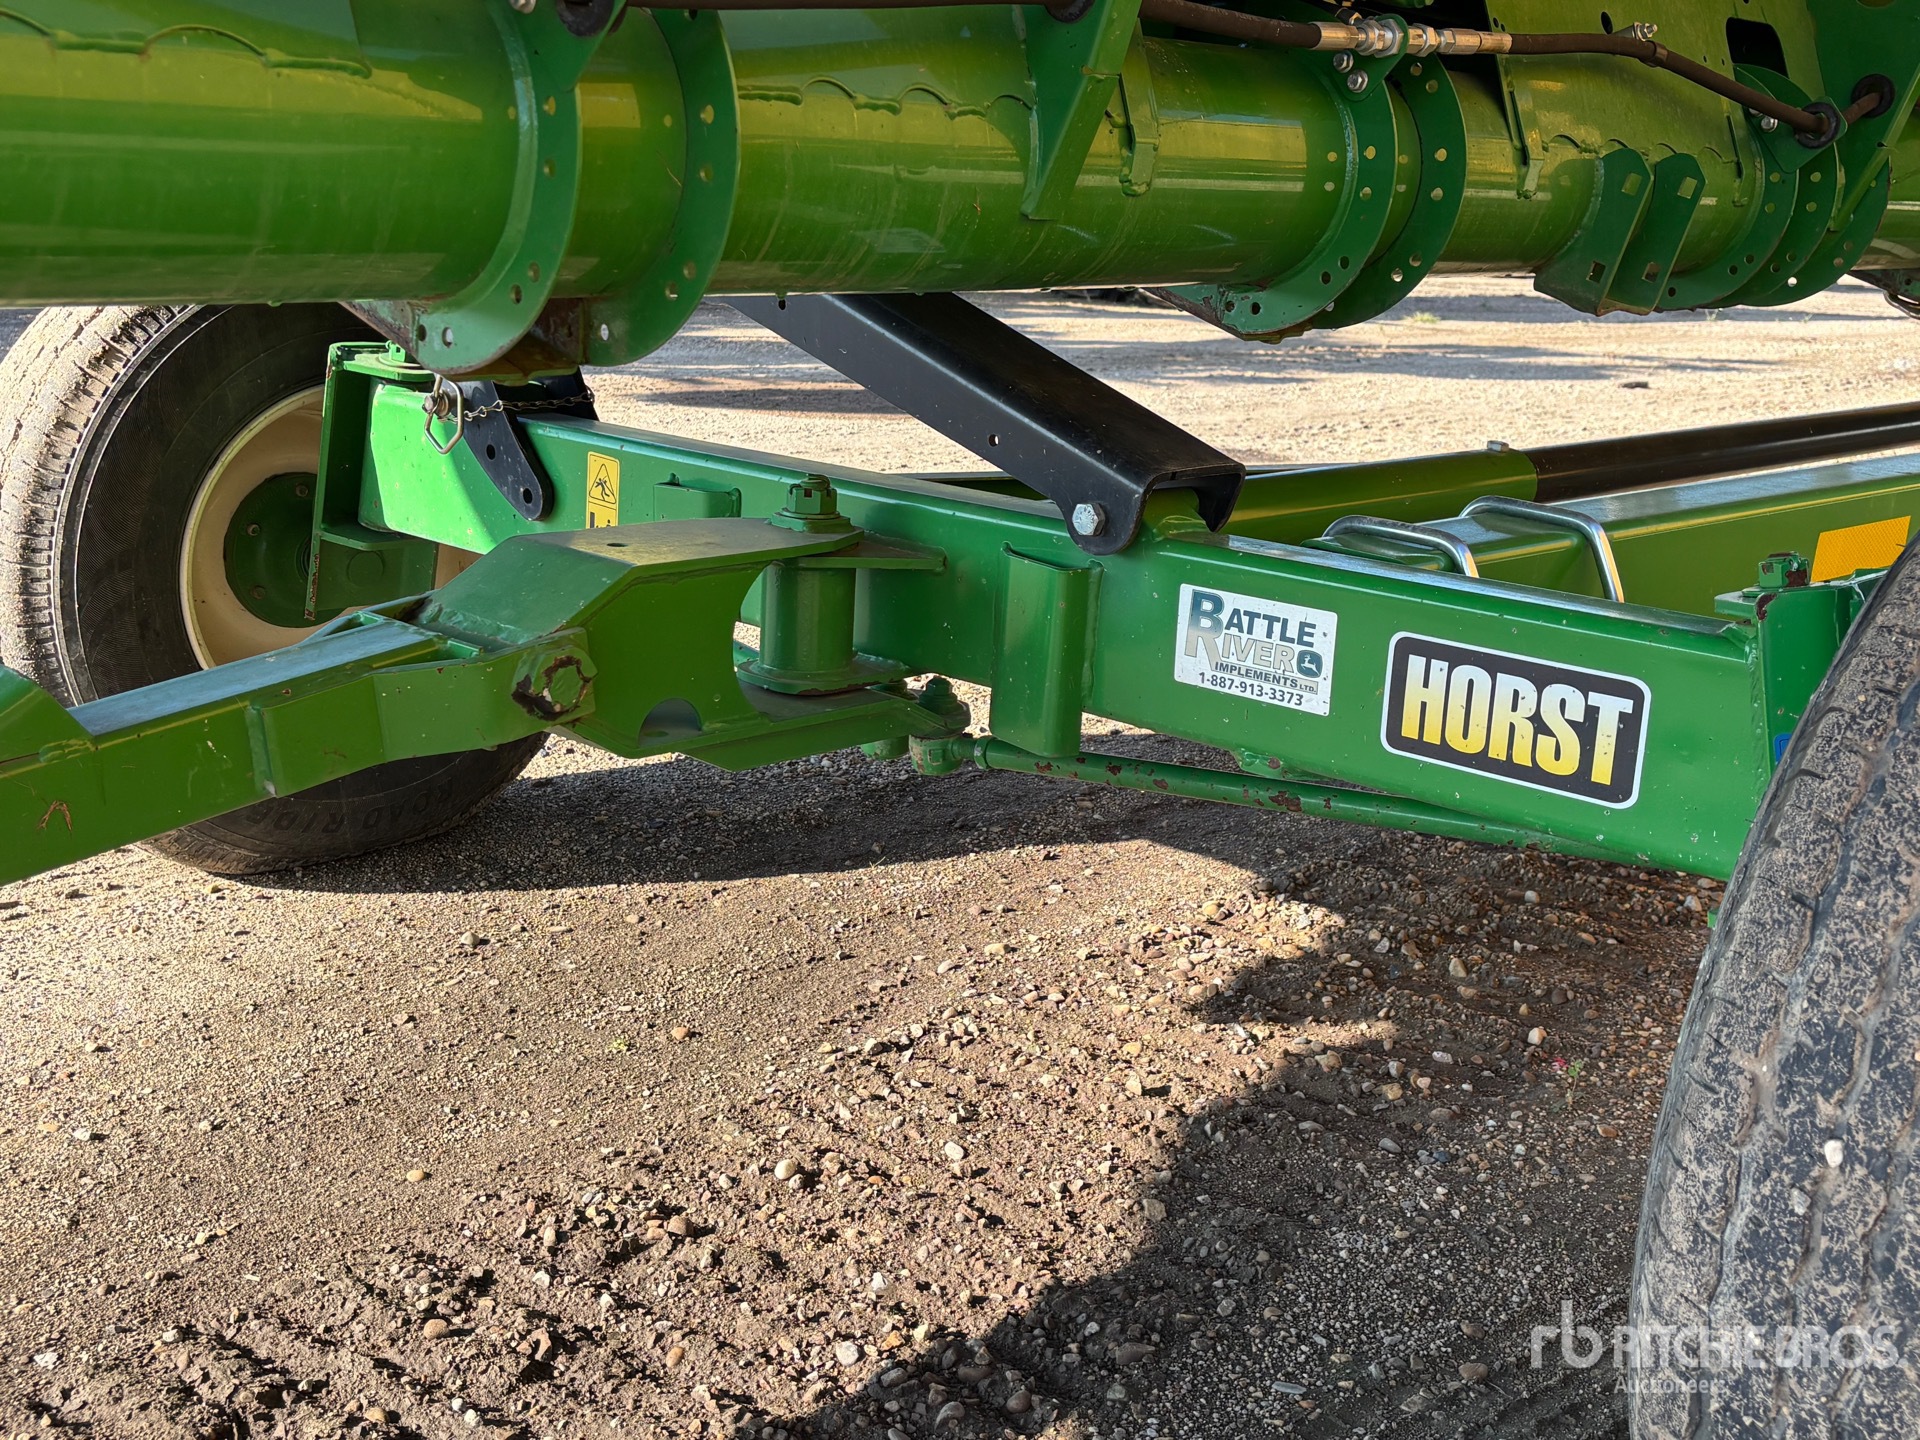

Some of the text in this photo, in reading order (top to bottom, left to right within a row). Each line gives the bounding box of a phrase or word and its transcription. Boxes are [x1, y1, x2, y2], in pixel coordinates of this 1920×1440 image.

[1188, 589, 1316, 648] BATTLE
[1184, 630, 1296, 673] RIVER
[1198, 672, 1304, 706] 1-887-913-3373
[1214, 661, 1317, 693] IMPLEMENTS LTD.
[1401, 654, 1634, 786] HORST
